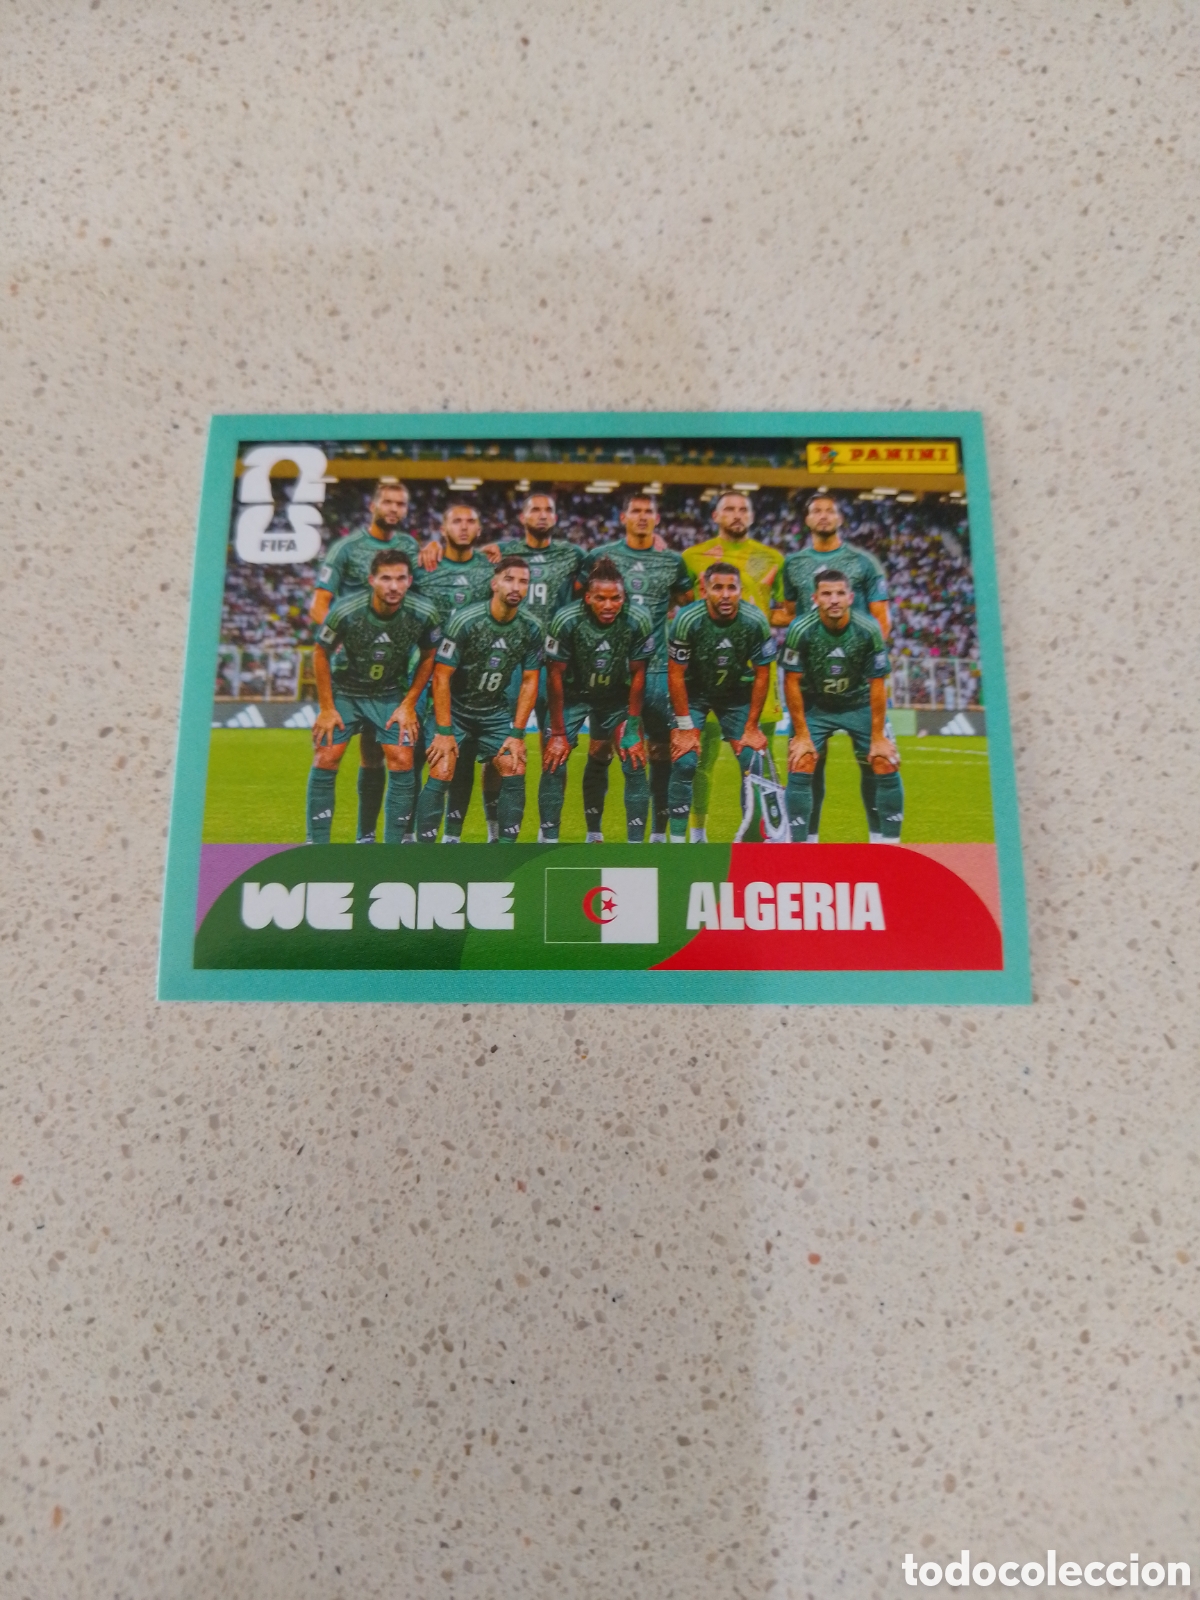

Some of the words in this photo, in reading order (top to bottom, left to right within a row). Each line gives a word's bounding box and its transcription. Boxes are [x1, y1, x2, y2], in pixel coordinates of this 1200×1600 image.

[850, 448, 949, 462] PANINI
[260, 539, 298, 552] FIFA
[529, 583, 548, 605] 19
[370, 664, 384, 680] 8
[589, 672, 610, 688] 14
[715, 669, 729, 685] 7
[478, 671, 503, 691] 18
[823, 677, 850, 694] 20
[241, 881, 355, 930] WE
[368, 881, 515, 930] ARE
[685, 881, 886, 930] ALGERIA
